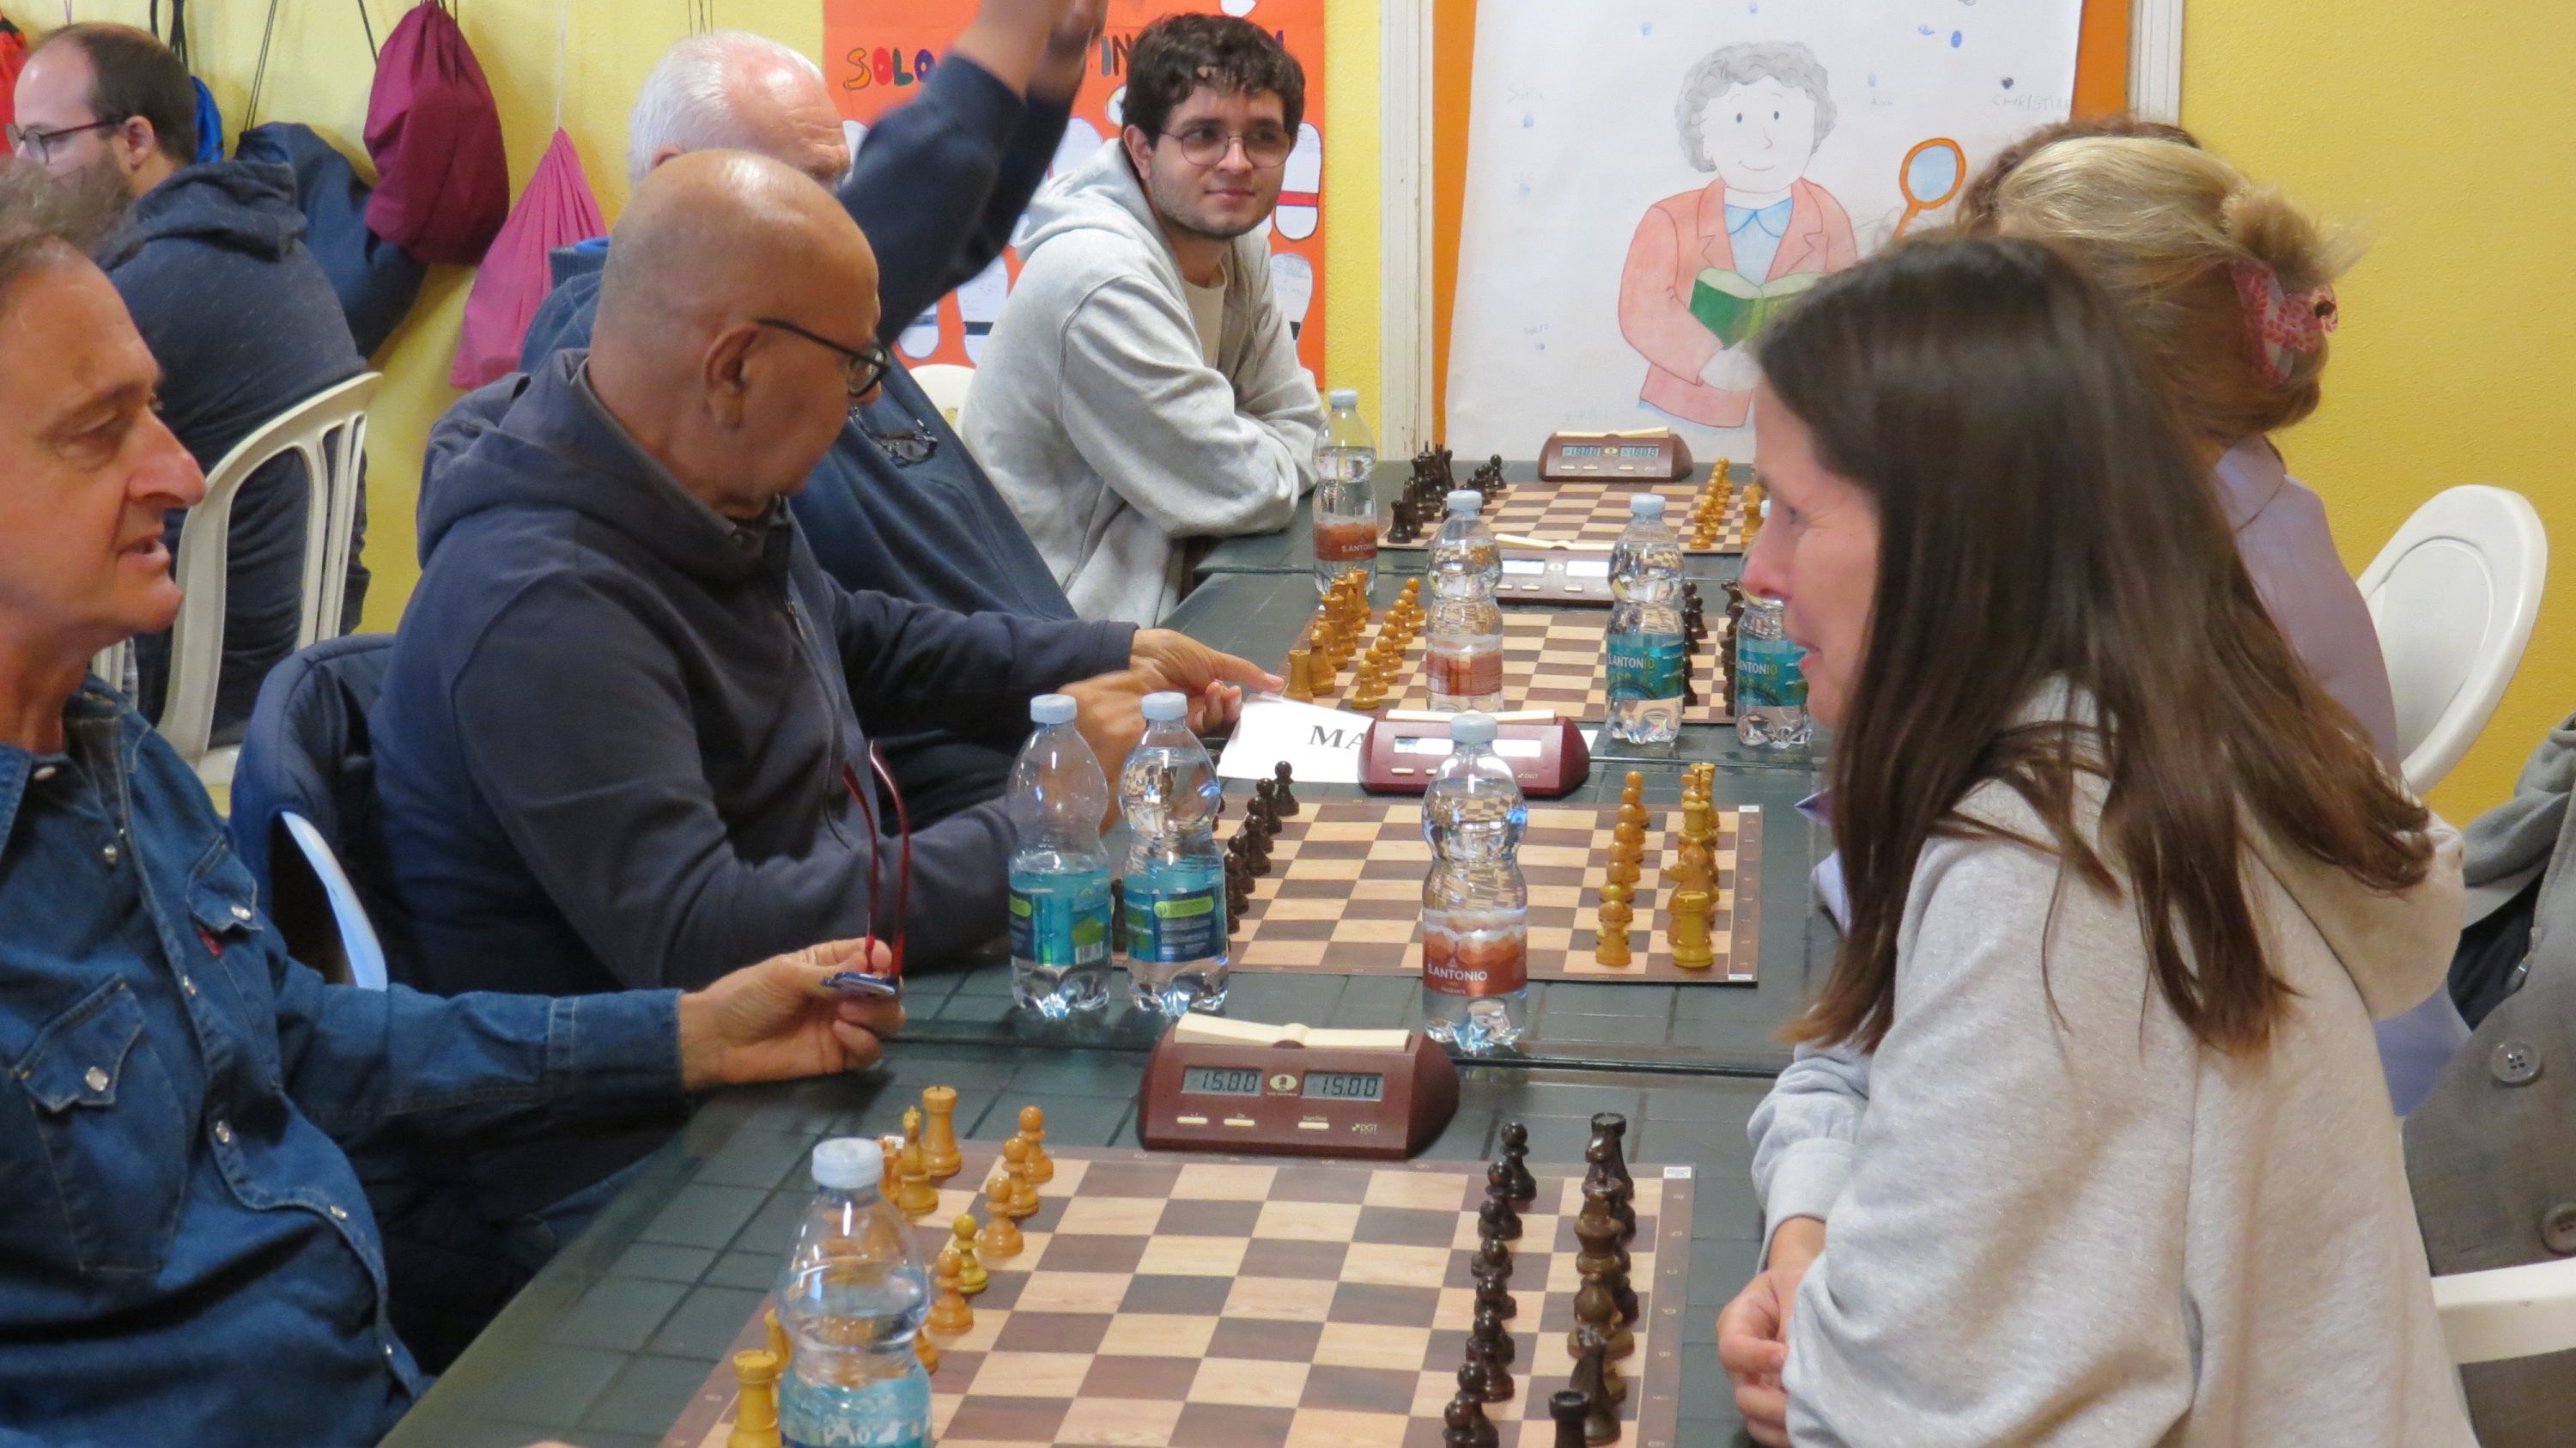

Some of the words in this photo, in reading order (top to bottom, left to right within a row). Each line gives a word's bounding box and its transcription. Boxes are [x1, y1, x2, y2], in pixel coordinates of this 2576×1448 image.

[842, 46, 938, 91] SOLO
[1427, 964, 1488, 981] S.ANTONIO
[1203, 1072, 1258, 1092] 15.00
[1322, 1076, 1378, 1098] 15.00
